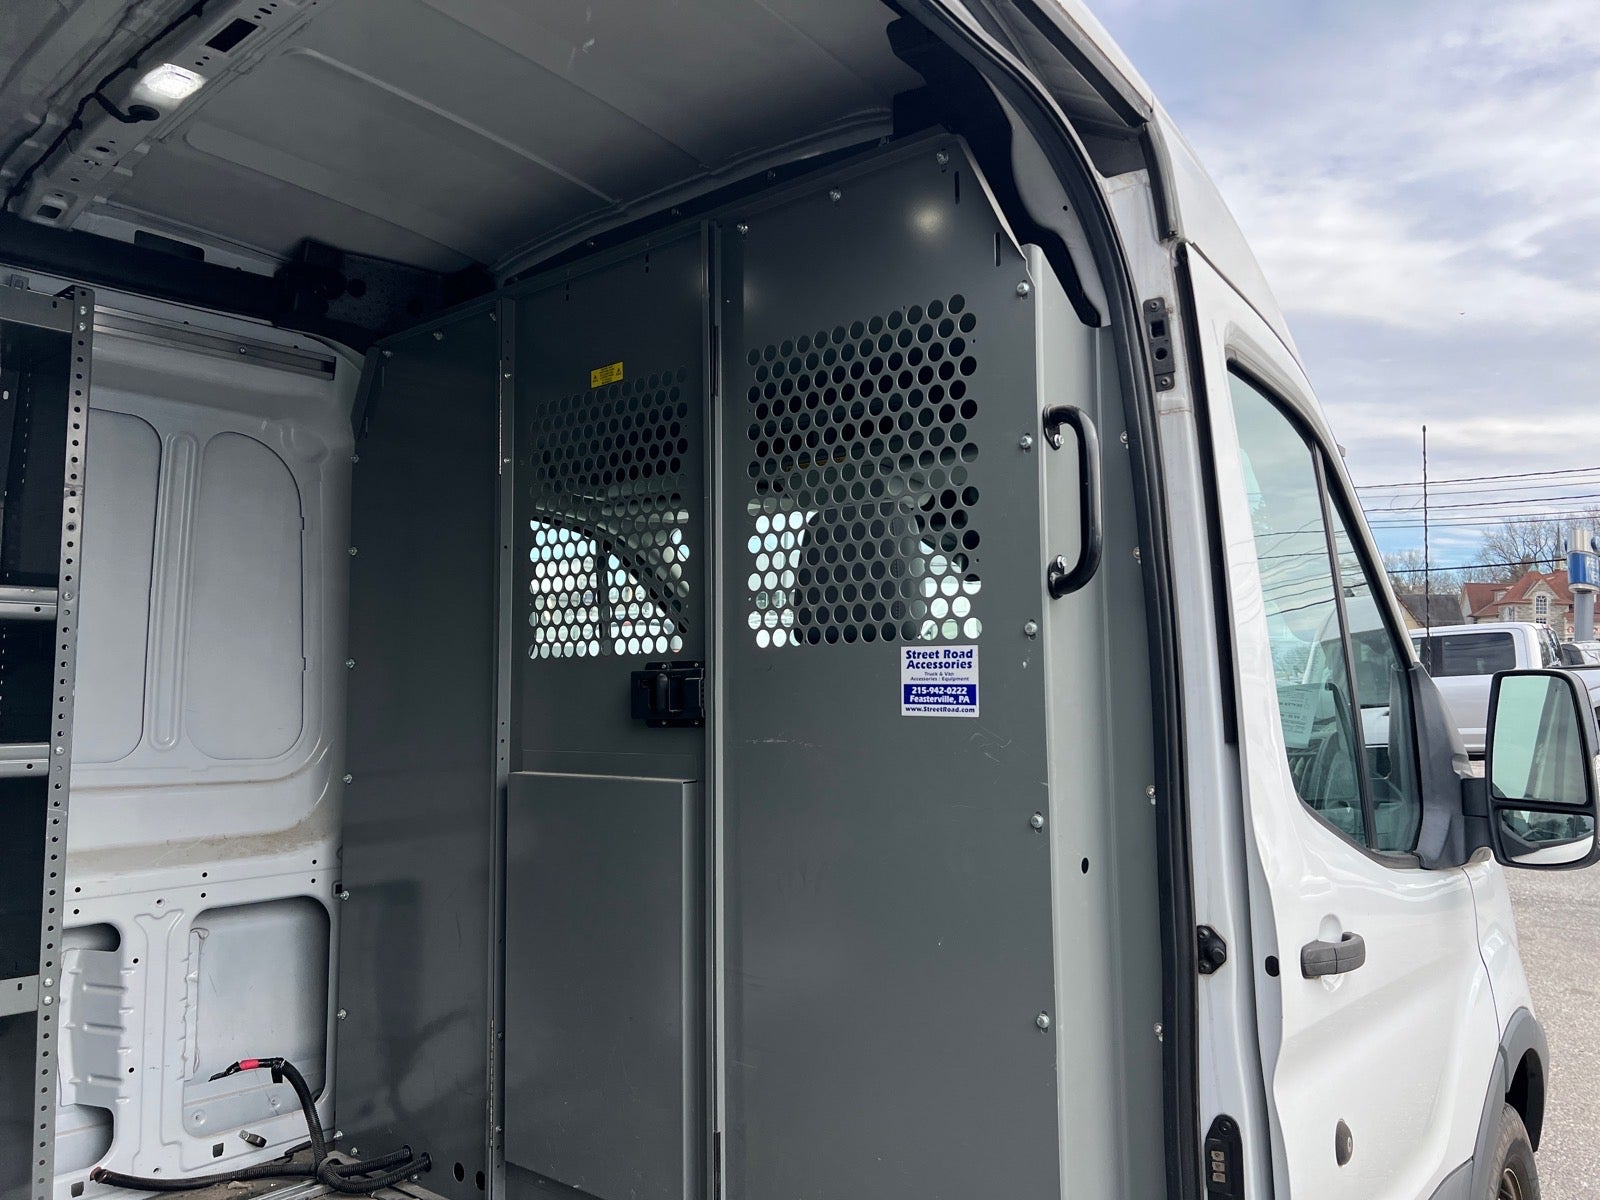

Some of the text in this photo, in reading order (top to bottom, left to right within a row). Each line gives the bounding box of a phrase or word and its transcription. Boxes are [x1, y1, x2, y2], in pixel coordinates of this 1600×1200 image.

[905, 648, 973, 660] Street Road
[906, 659, 973, 670] Accessories
[911, 686, 968, 695] 215-942-0222
[909, 694, 970, 704] Feasterville, PA
